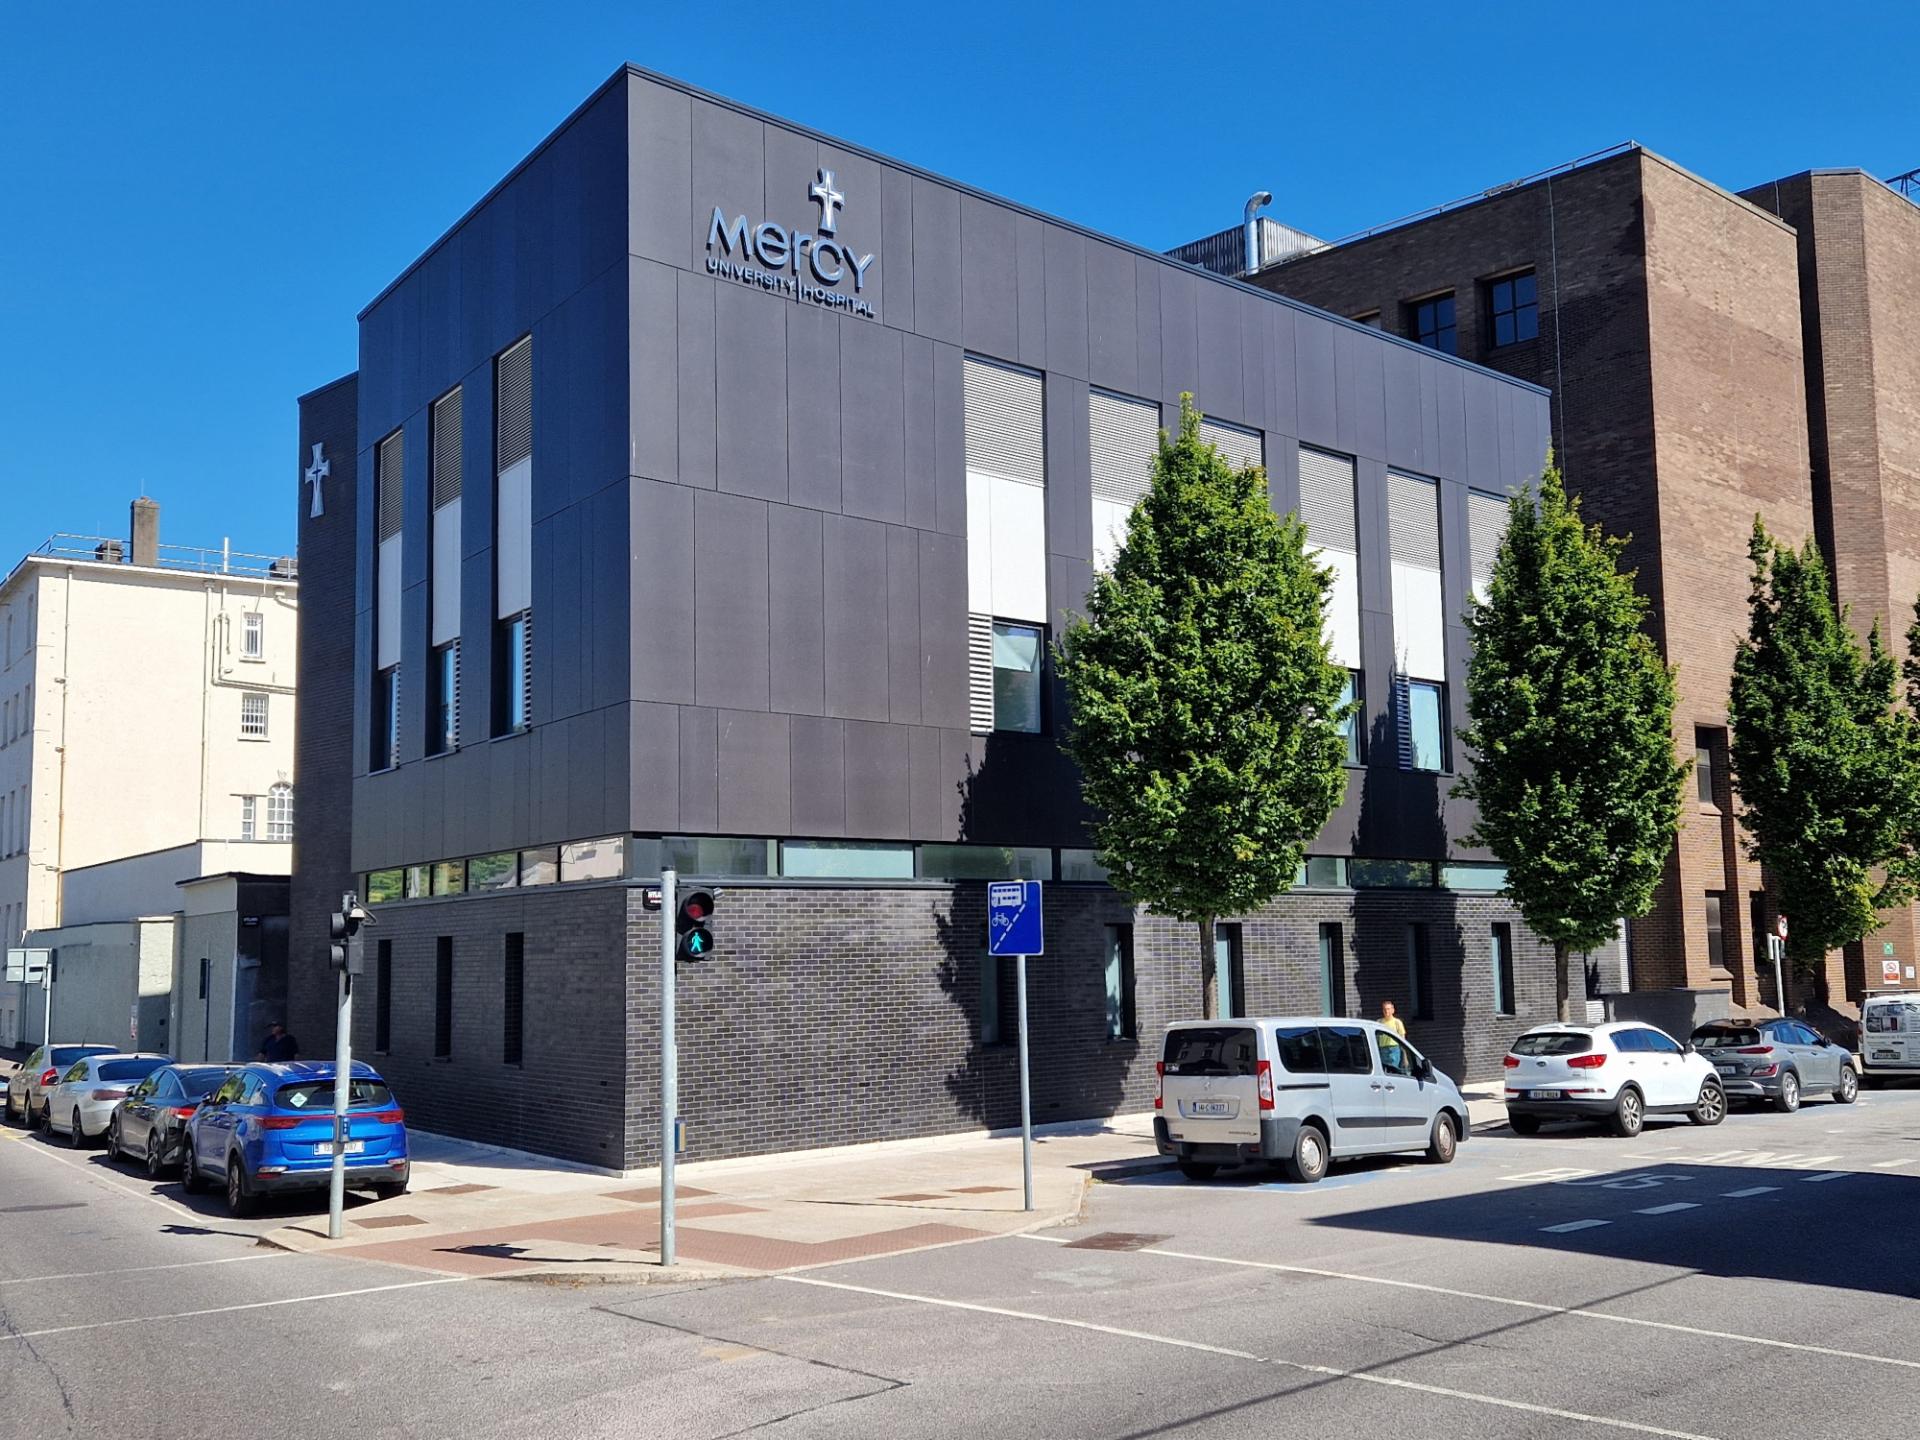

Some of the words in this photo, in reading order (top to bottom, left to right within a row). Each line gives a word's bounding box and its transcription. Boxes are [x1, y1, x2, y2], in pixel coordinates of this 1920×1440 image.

[707, 257, 796, 292] UNIVERSITY
[804, 284, 877, 315] HOSPITAL
[1495, 1167, 1697, 1190] BUS
